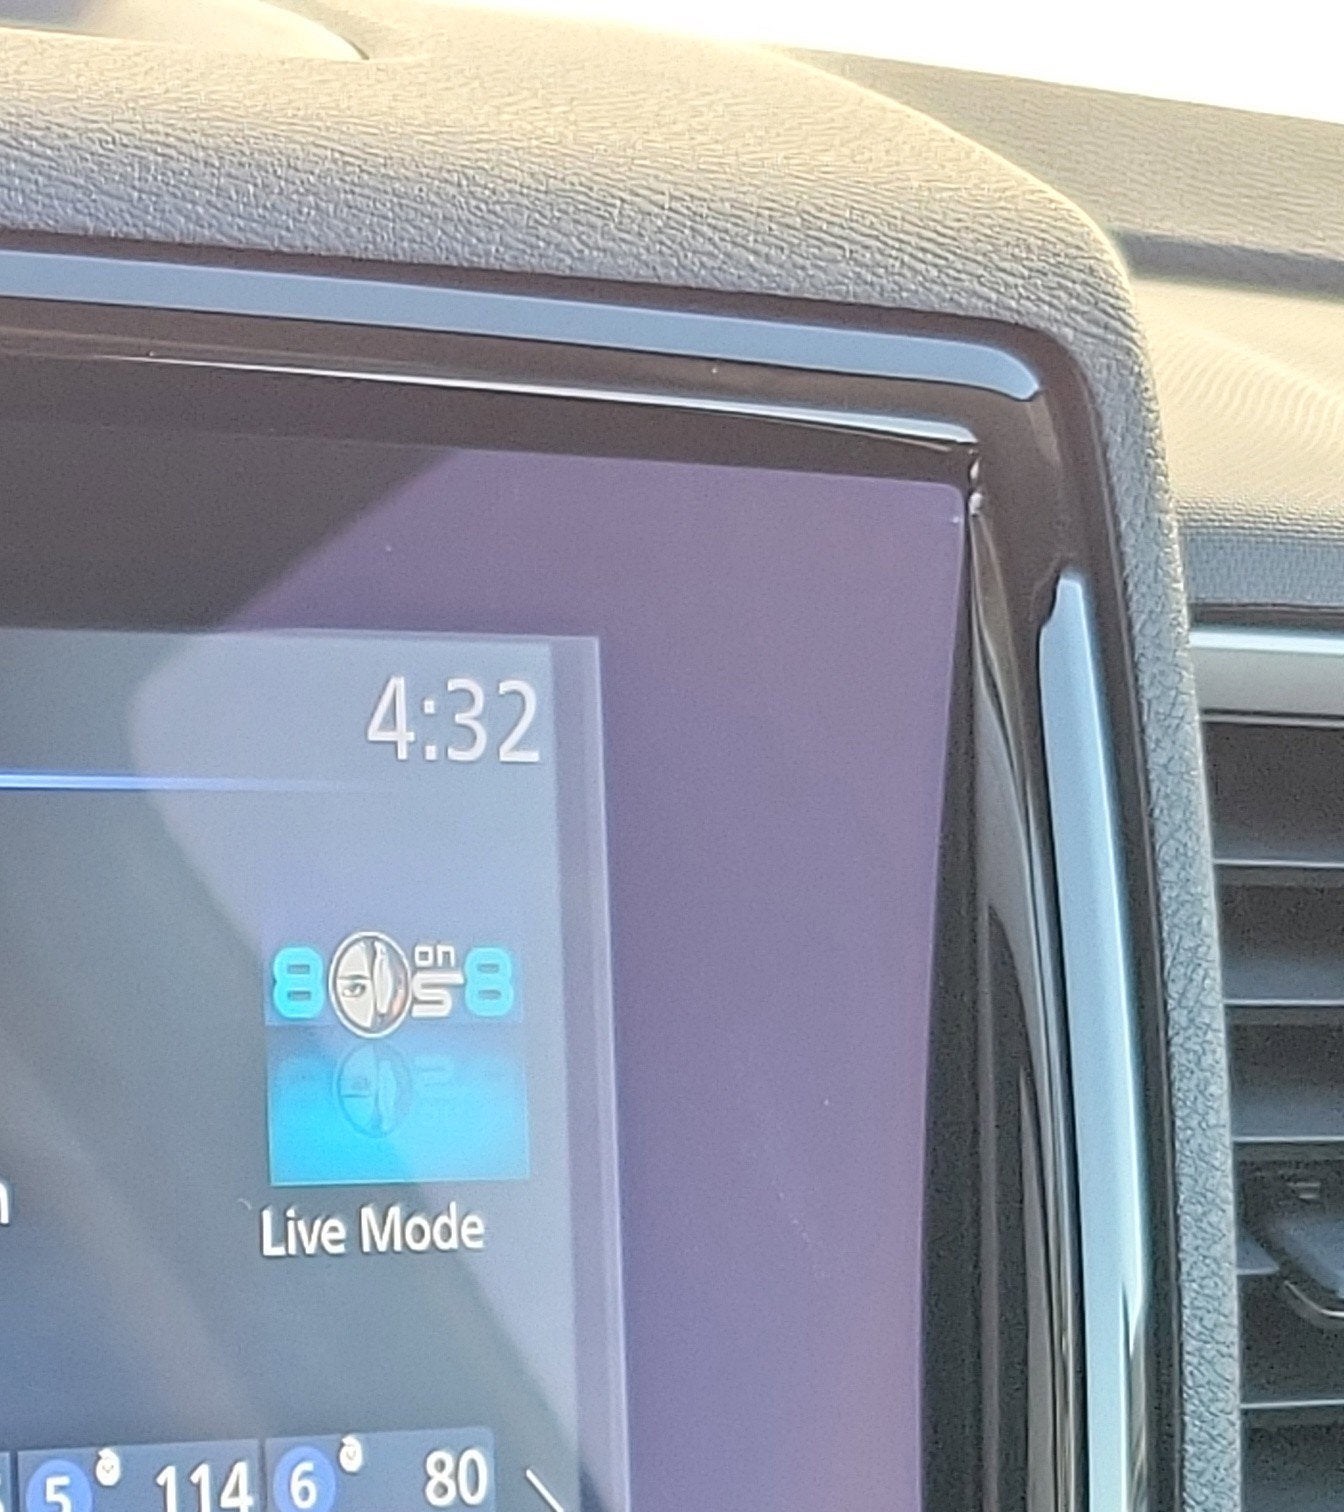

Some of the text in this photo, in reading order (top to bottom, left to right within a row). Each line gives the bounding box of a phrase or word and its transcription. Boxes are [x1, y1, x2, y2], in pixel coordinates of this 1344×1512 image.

[367, 675, 542, 763] 4:32
[261, 1201, 486, 1257] Live Mode
[290, 1462, 318, 1508] 6
[424, 1448, 488, 1505] 80
